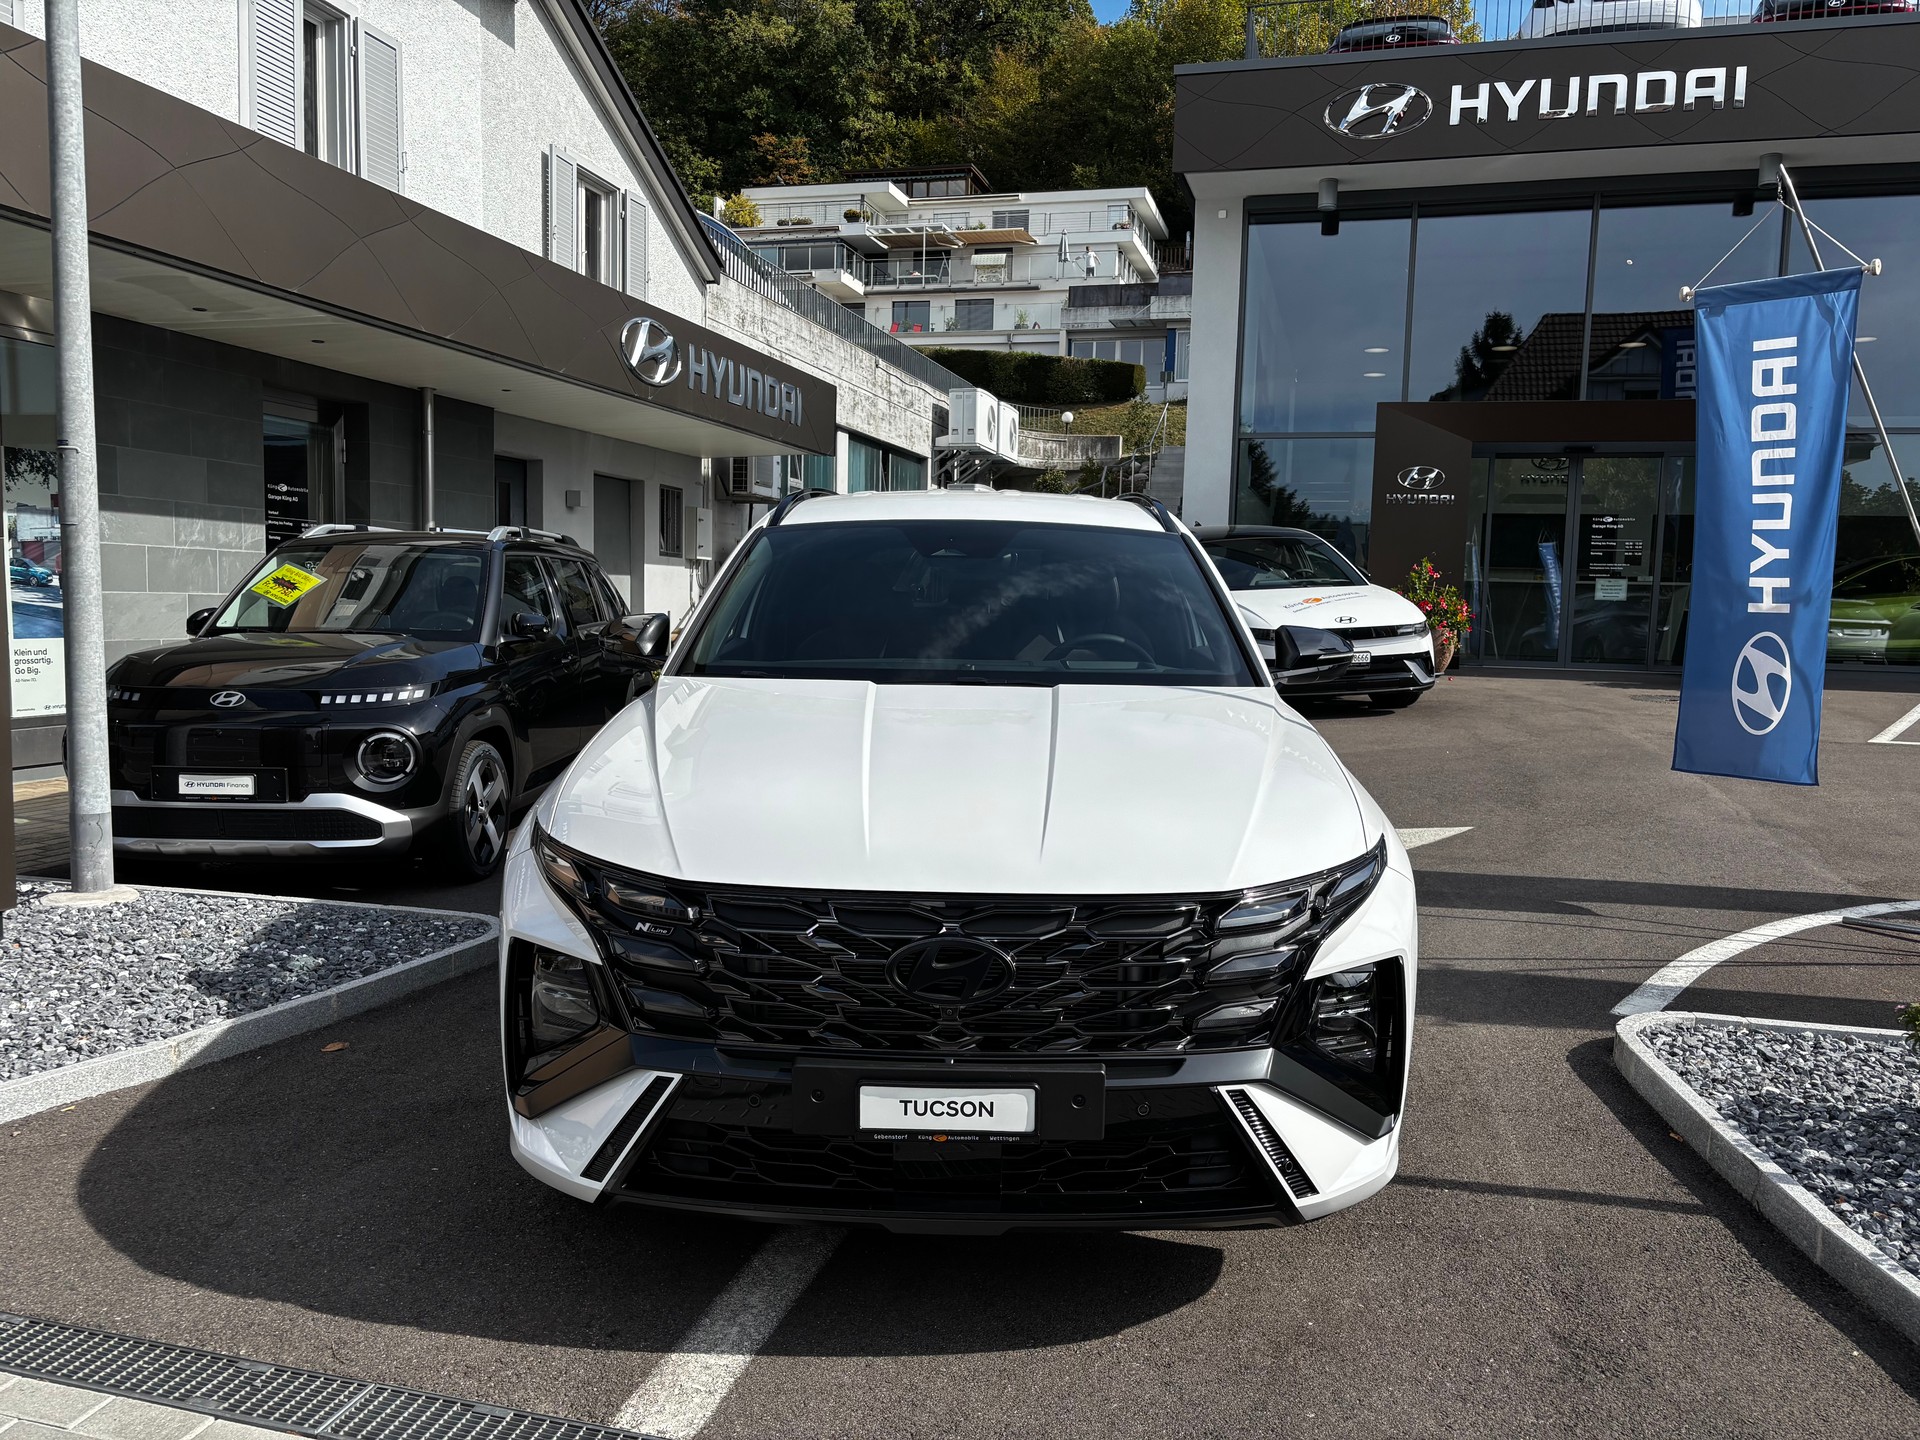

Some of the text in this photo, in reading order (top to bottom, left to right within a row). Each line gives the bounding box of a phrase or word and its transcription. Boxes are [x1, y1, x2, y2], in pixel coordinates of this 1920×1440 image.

[1448, 65, 1748, 127] HYUNDAI
[688, 343, 803, 427] HYUNDAI
[1748, 336, 1798, 613] HYUNDAI
[1386, 493, 1455, 504] HYUNDAI
[14, 648, 32, 656] Klein
[14, 656, 53, 666] grossartig.
[27, 666, 41, 675] Big.
[635, 922, 651, 932] N
[898, 1100, 994, 1118] TUCSON
